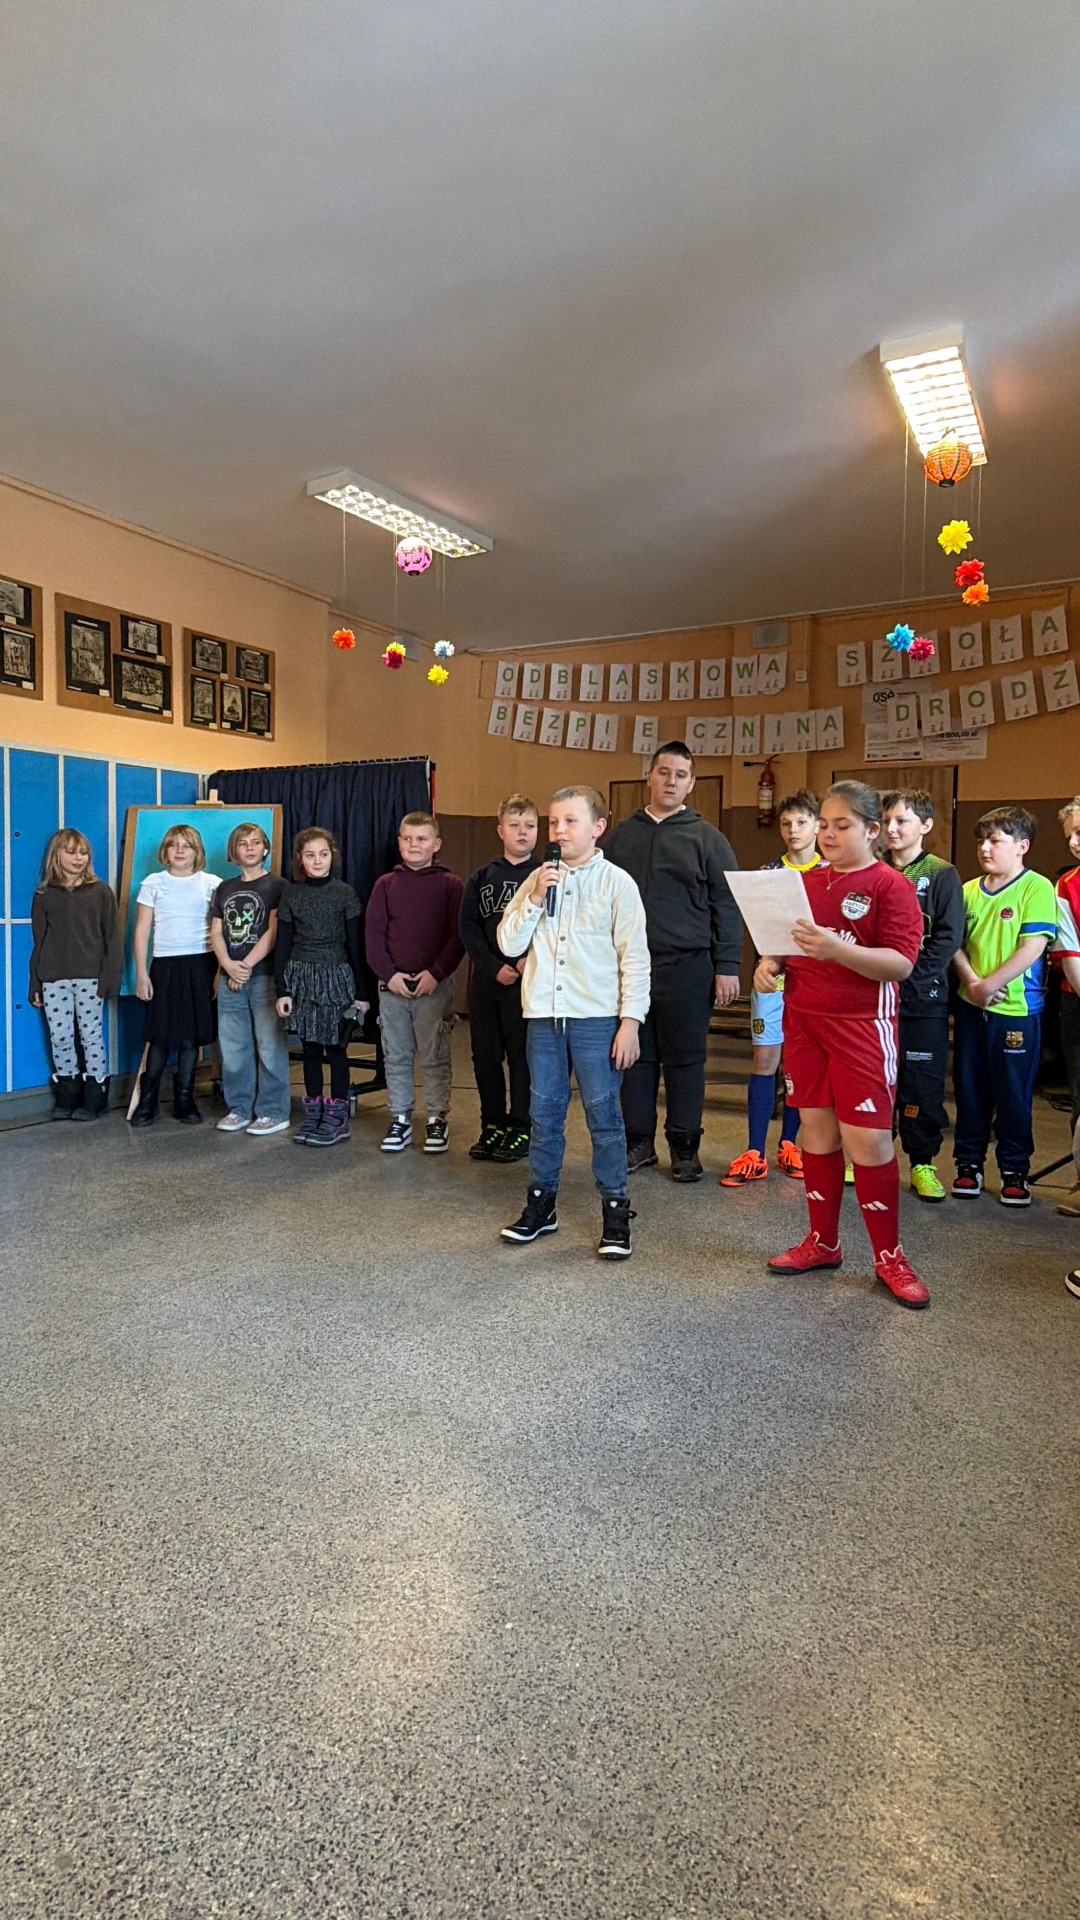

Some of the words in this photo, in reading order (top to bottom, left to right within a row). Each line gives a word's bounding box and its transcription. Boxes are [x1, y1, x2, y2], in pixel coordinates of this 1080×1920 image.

[502, 658, 781, 687] ODBLASKOWA
[845, 615, 1059, 667] SZOŁA
[479, 881, 518, 918] GA
